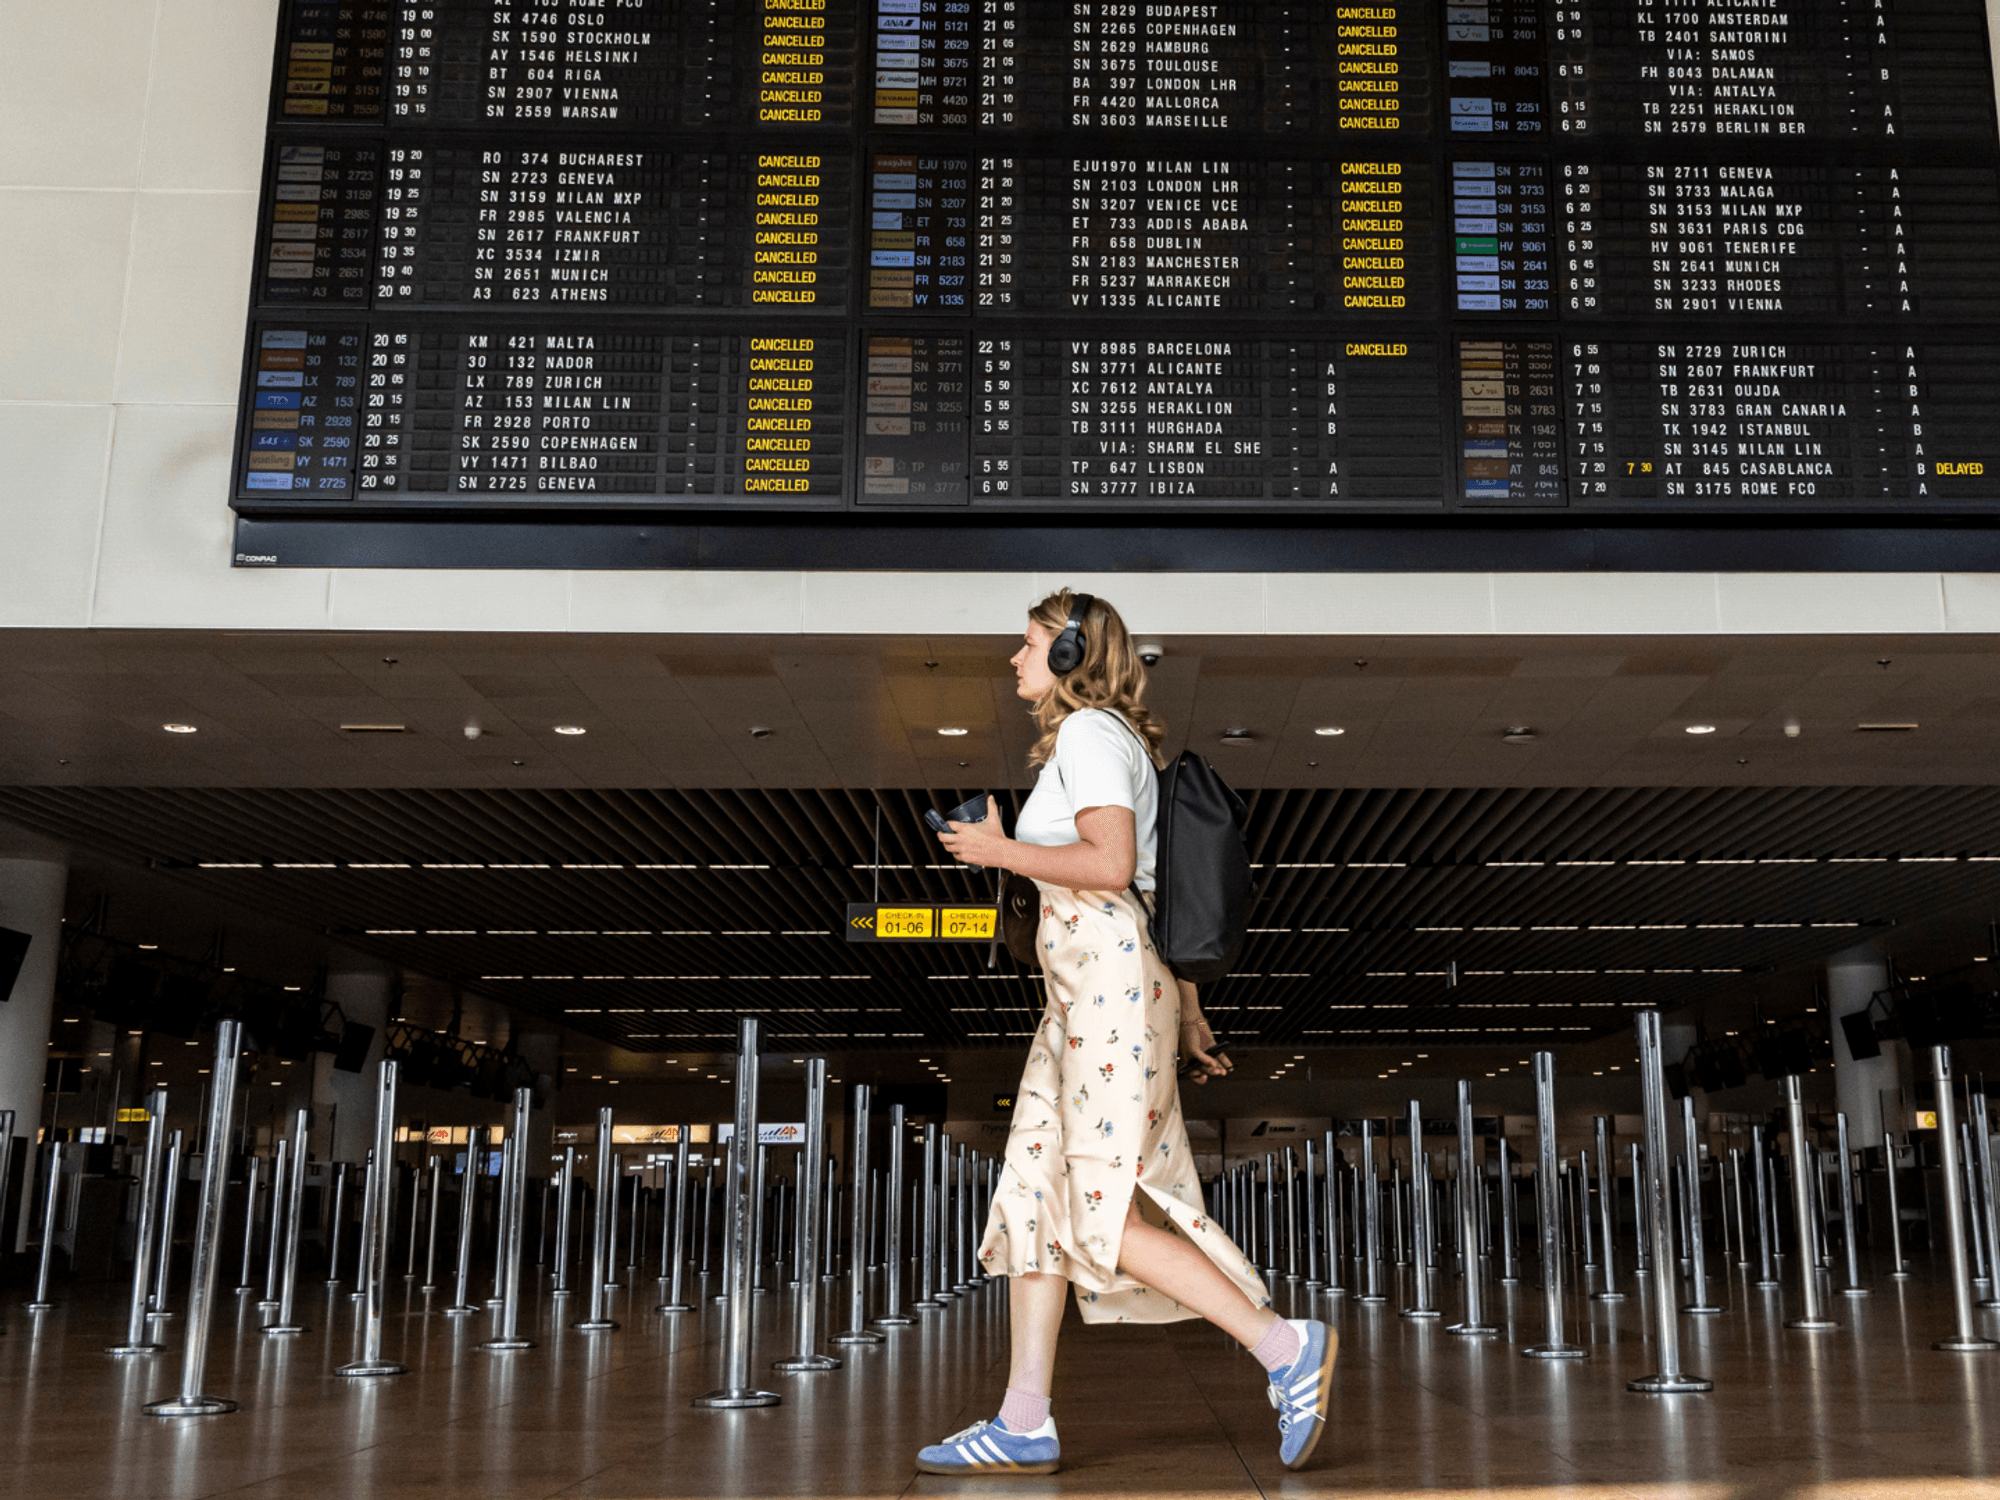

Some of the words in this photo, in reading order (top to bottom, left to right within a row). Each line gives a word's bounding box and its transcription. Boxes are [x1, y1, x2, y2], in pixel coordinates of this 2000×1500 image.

[883, 19, 904, 27] ANA
[922, 21, 936, 31] NH
[944, 21, 968, 31] 5121
[983, 20, 996, 31] 21
[1003, 21, 1015, 29] 05
[1074, 22, 1092, 33] SN
[1102, 23, 1137, 34] 2265
[1147, 23, 1237, 35] COPENHAGEN
[1338, 26, 1399, 37] CANCELLED
[401, 28, 415, 40] 19
[420, 28, 433, 40] 00
[493, 31, 511, 42] SK
[522, 32, 558, 43] 1590
[567, 32, 652, 44] STOCKHOLM
[764, 35, 826, 47] CANCELLED
[397, 66, 412, 77] 19
[418, 66, 430, 75] 10
[490, 68, 509, 79] BT
[528, 69, 555, 80] 604
[565, 69, 603, 80] RIGA
[762, 72, 825, 84] CANCELLED
[920, 95, 933, 105] FR
[942, 95, 967, 105] 4420
[981, 94, 995, 105] 21
[1002, 94, 1014, 103] 10
[1074, 96, 1091, 106] FR
[1101, 96, 1137, 107] 4420
[1146, 97, 1221, 109] MALLORCA
[1339, 99, 1401, 110] CANCELLED
[1493, 102, 1507, 112] TB
[1516, 103, 1539, 113] 2251
[1560, 102, 1569, 113] 6
[1574, 102, 1586, 110] 15
[1643, 103, 1661, 114] TB
[1671, 103, 1704, 114] 2251
[1715, 104, 1796, 115] HERAKLION
[1885, 105, 1894, 116] A
[390, 150, 405, 162] 19
[410, 150, 423, 159] 20
[483, 152, 503, 163] RO
[522, 153, 550, 164] 374
[560, 153, 644, 166] BUCHAREST
[759, 156, 822, 167] CANCELLED
[918, 160, 938, 170] EJU
[943, 160, 967, 170] 1970
[981, 158, 995, 170] 21
[1002, 159, 1013, 168] 15
[1074, 160, 1138, 172] EJU1970
[1147, 161, 1193, 173] MILAN
[1203, 162, 1230, 173] LIN
[1341, 163, 1403, 174] CANCELLED
[385, 207, 400, 219] 19
[405, 208, 418, 217] 25
[480, 210, 498, 221] FR
[509, 210, 546, 222] 2985
[556, 211, 632, 223] VALENCIA
[756, 213, 820, 225] CANCELLED
[1566, 221, 1575, 233] 6
[1580, 221, 1592, 231] 25
[1650, 222, 1669, 234] SN
[1678, 223, 1713, 234] 3631
[1724, 223, 1769, 234] PARIS
[1778, 223, 1806, 235] CDG
[1896, 224, 1905, 235] A
[915, 294, 928, 305] VY
[939, 295, 964, 305] 1335
[978, 293, 994, 305] 22
[999, 293, 1011, 302] 15
[1072, 294, 1090, 305] VY
[1101, 295, 1137, 306] 1335
[1147, 295, 1222, 306] ALICANTE
[1344, 295, 1407, 307] CANCELLED
[1570, 297, 1579, 309] 6
[1584, 297, 1596, 306] 50
[1656, 298, 1674, 309] SN
[1683, 299, 1718, 310] 2901
[1728, 299, 1784, 310] VIENNA
[1902, 300, 1912, 311] A
[373, 334, 390, 346] 20
[394, 334, 408, 344] 05
[469, 336, 490, 347] KM
[509, 336, 536, 348] 421
[547, 337, 596, 349] MALTA
[751, 338, 815, 351] CANCELLED
[978, 341, 993, 353] 22
[999, 341, 1011, 350] 15
[1072, 342, 1090, 354] VY
[1101, 342, 1138, 354] 8985
[1148, 343, 1233, 355] BARCELONA
[1346, 344, 1409, 355] CANCELLED
[1506, 385, 1520, 396] TB
[1529, 385, 1554, 396] 2631
[1576, 403, 1585, 415] 7
[1590, 403, 1602, 413] 15
[1662, 404, 1680, 415] SN
[1690, 404, 1727, 416] 3783
[1736, 404, 1773, 416] GRAN
[1782, 404, 1848, 416] CANARIA
[1912, 405, 1921, 416] A
[1508, 424, 1522, 435] TK
[1532, 425, 1557, 435] 1942
[299, 436, 313, 447] SK
[323, 437, 350, 447] 2590
[364, 434, 381, 447] 20
[386, 435, 399, 444] 25
[462, 436, 482, 448] SK
[492, 436, 531, 448] 2590
[541, 436, 639, 449] COPENHAGEN
[747, 438, 813, 451] CANCELLED
[1100, 441, 1136, 453] VIA:
[1148, 442, 1196, 453] SHARM
[1206, 442, 1224, 454] EL
[1234, 442, 1262, 454] SHE
[297, 456, 311, 467] VY
[322, 456, 347, 467] 1471
[362, 455, 379, 467] 20
[384, 455, 397, 465] 35
[461, 456, 481, 468] VY
[492, 456, 528, 468] 1471
[540, 457, 599, 469] BILBAO
[746, 458, 812, 471] CANCELLED
[1509, 464, 1522, 475] AT
[1538, 464, 1559, 475] 845
[1579, 463, 1588, 474] 7
[1593, 463, 1606, 472] 20
[1627, 463, 1634, 474] 7
[1640, 463, 1652, 473] 30
[1666, 463, 1684, 474] AT
[1703, 463, 1731, 475] 845
[1741, 463, 1835, 475] CASABLANCA
[1917, 463, 1927, 475] B
[1936, 463, 1985, 475] DELAYED
[950, 912, 989, 920] CHECK-IN
[885, 922, 924, 934] 01-06
[950, 922, 988, 934] 07-14
